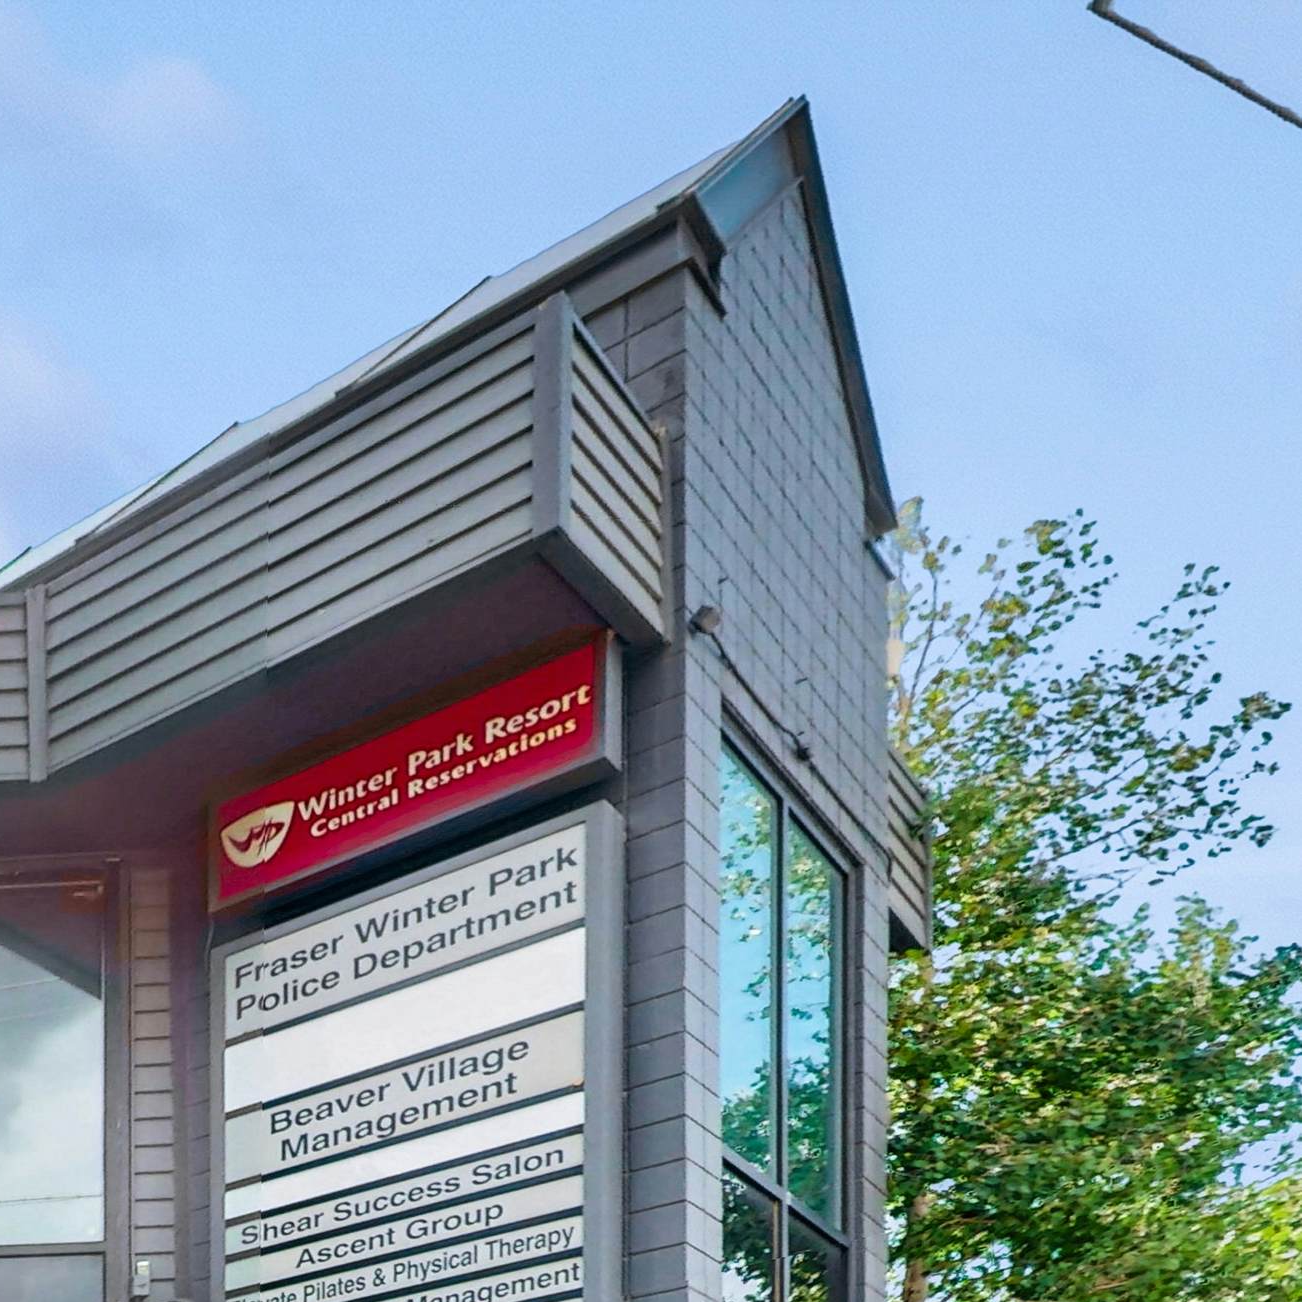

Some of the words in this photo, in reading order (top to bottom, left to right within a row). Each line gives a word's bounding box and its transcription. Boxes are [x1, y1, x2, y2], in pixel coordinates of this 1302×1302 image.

[299, 765, 398, 821] Winter
[408, 733, 474, 775] Park
[485, 684, 591, 743] Resort
[310, 788, 398, 837] Central
[408, 718, 578, 797] Reservations
[235, 935, 344, 989] Fraser
[355, 887, 475, 944] Winter
[488, 847, 578, 897] Park
[236, 971, 340, 1020] Police
[354, 882, 578, 979] Department
[271, 1083, 391, 1134] Beaver
[402, 1040, 531, 1092] Village
[281, 1073, 518, 1161] Management
[241, 1211, 324, 1245] Shear
[334, 1177, 460, 1221] Success
[471, 1148, 564, 1186] Salon
[296, 1229, 396, 1268] Ascent
[406, 1203, 503, 1240] Group
[373, 1270, 386, 1287] &
[393, 1245, 478, 1287] Physical
[485, 1224, 574, 1260] Therapy
